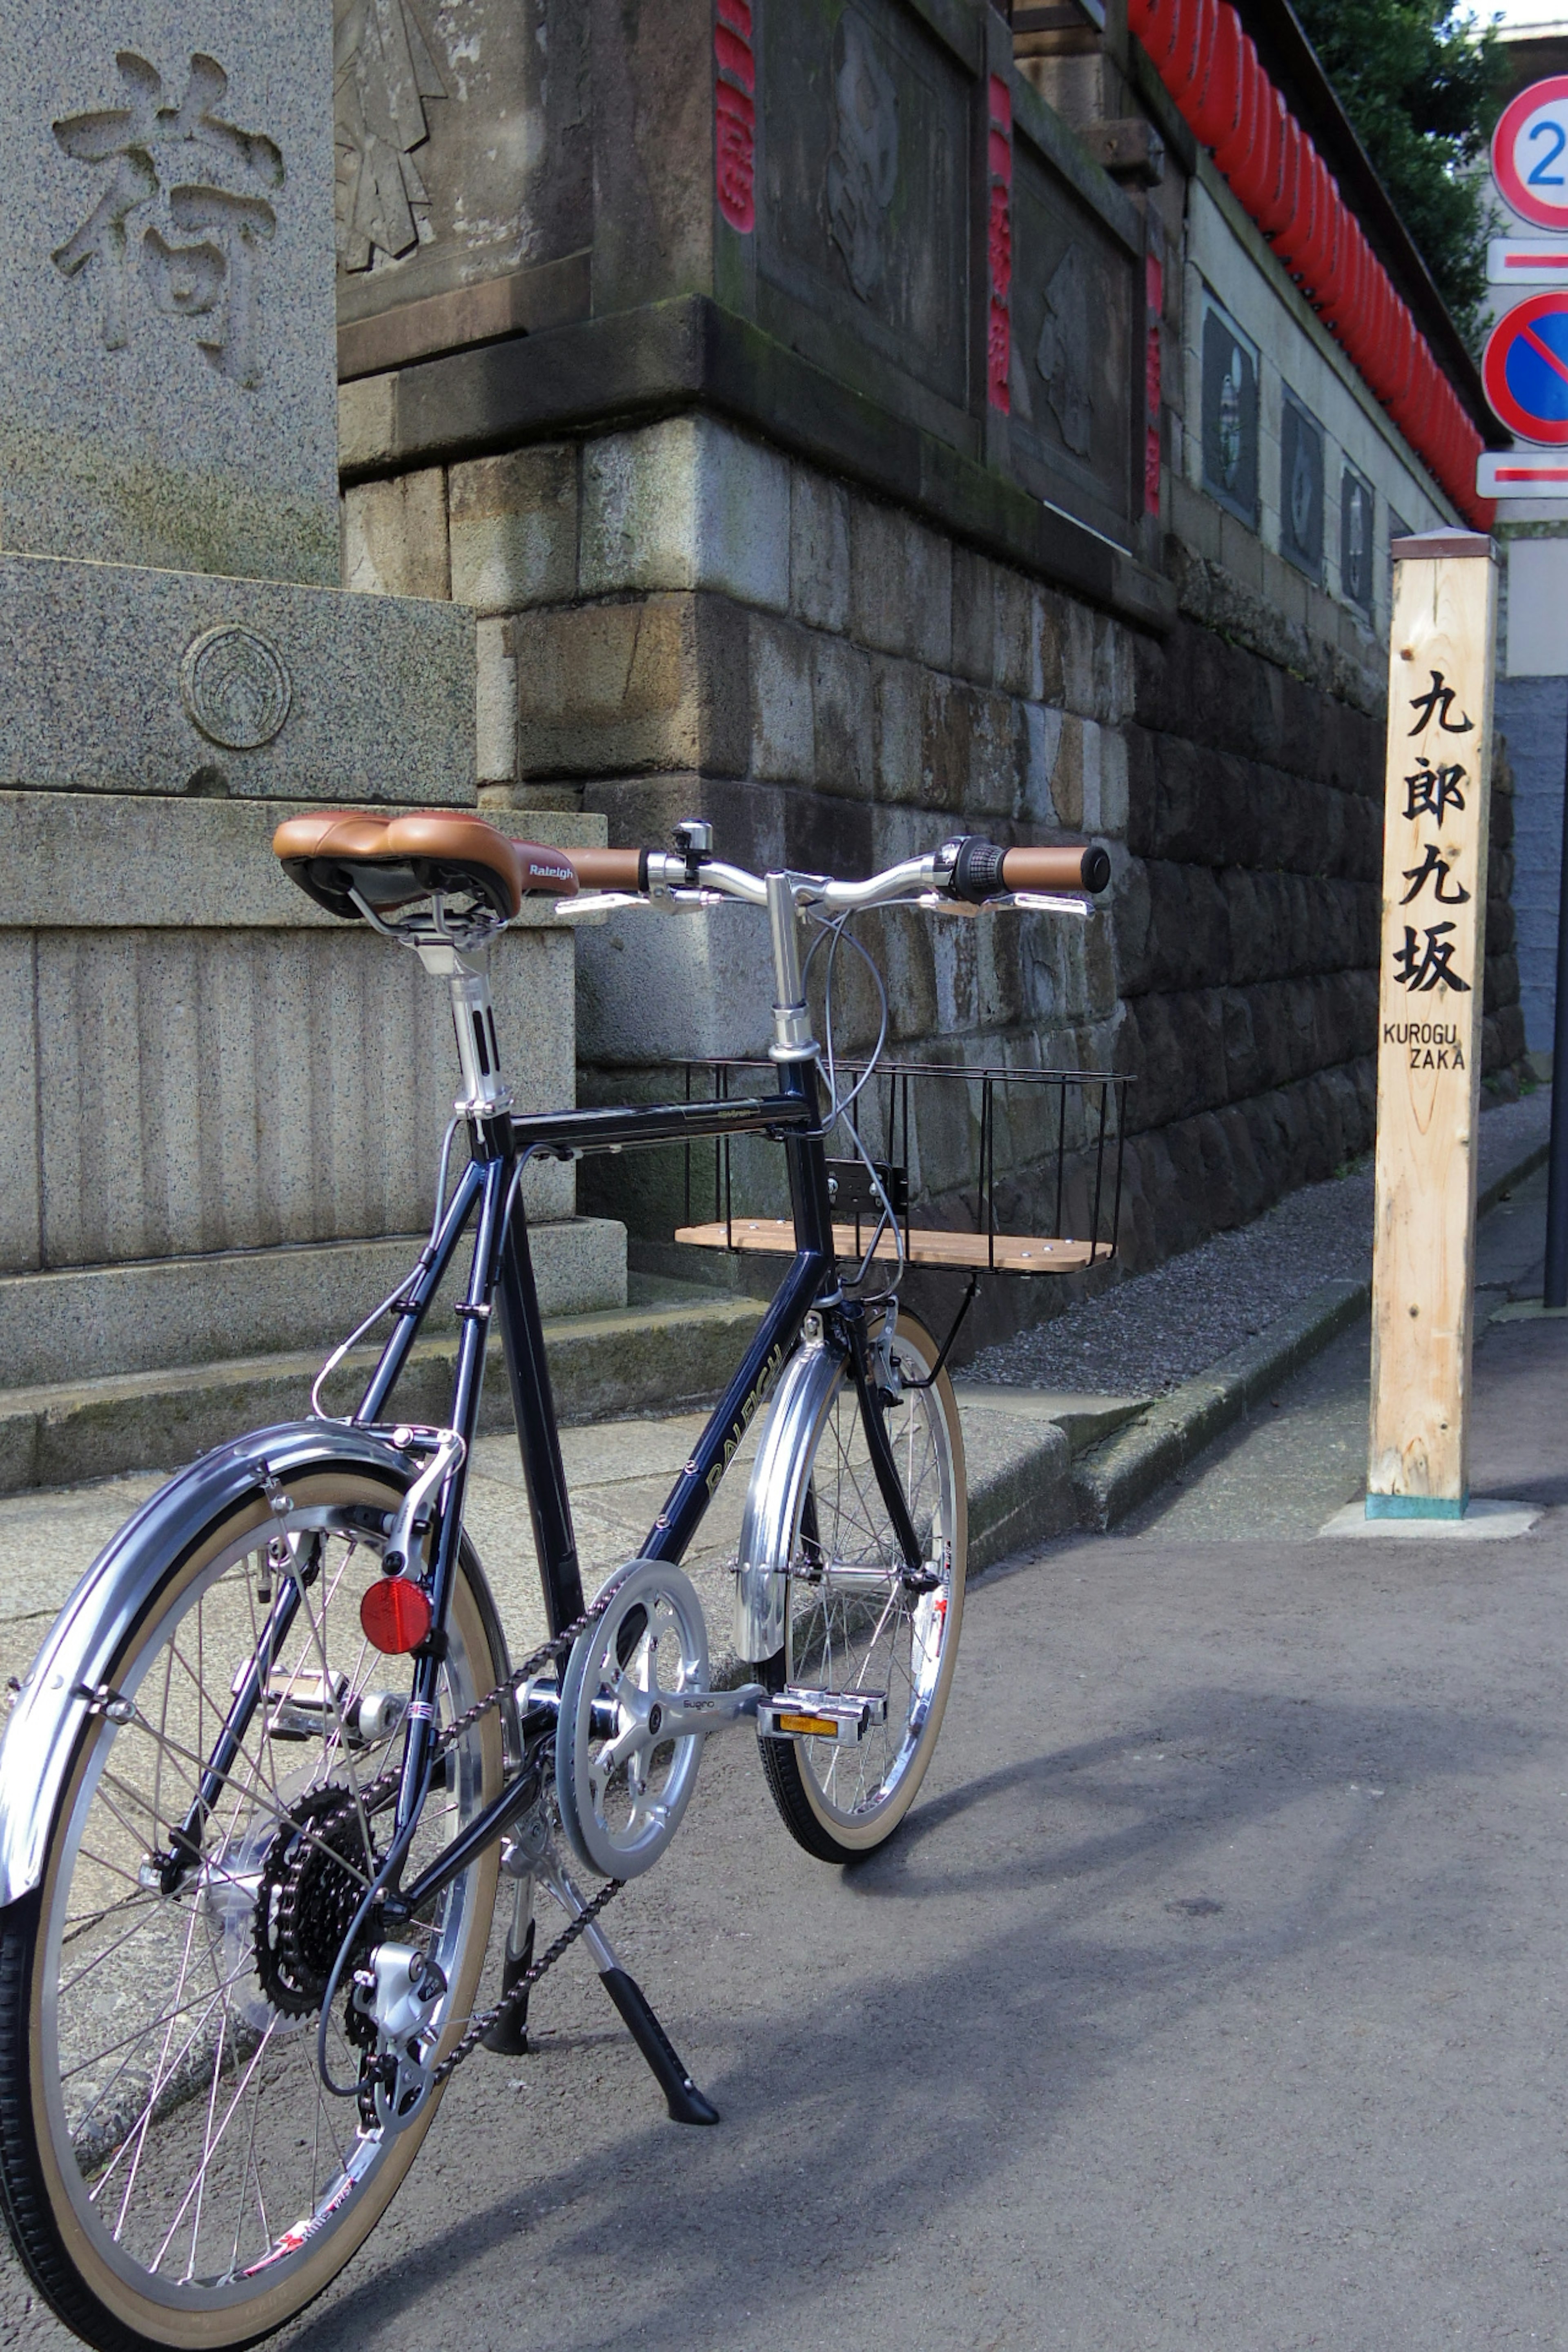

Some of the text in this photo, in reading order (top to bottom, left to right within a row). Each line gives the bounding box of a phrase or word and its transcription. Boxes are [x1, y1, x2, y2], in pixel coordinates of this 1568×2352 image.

[1528, 120, 1566, 185] 2
[1392, 670, 1474, 992] 九郎九坂
[529, 864, 573, 880] Raleigh
[1383, 1022, 1457, 1045] KUROGU
[1410, 1048, 1465, 1069] ZAKA
